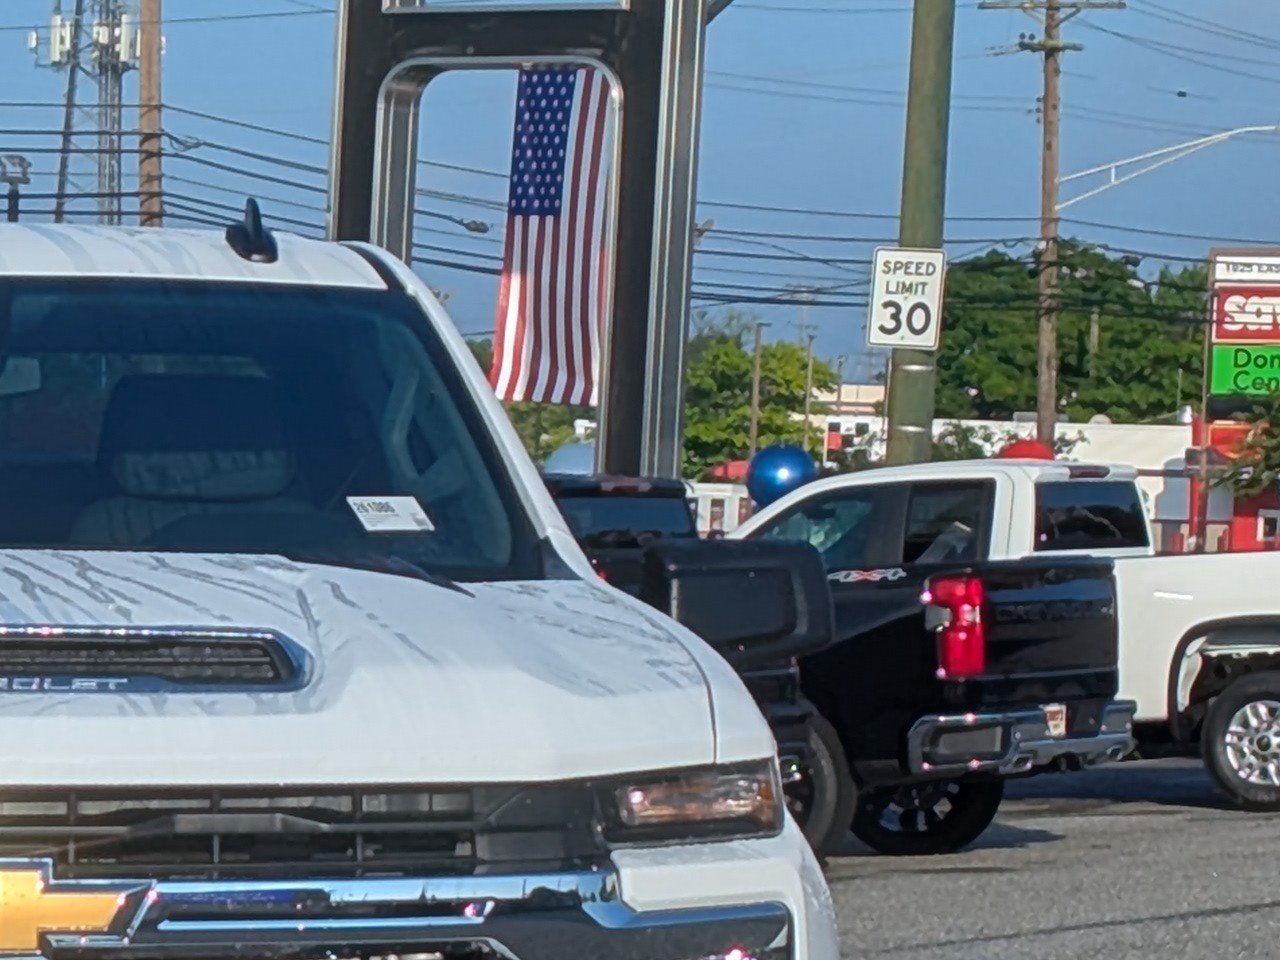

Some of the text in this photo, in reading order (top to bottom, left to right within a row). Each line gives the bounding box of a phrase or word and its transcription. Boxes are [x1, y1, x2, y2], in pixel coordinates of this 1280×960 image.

[881, 260, 936, 276] SPEED
[885, 281, 928, 295] LIMIT
[878, 300, 931, 335] 30
